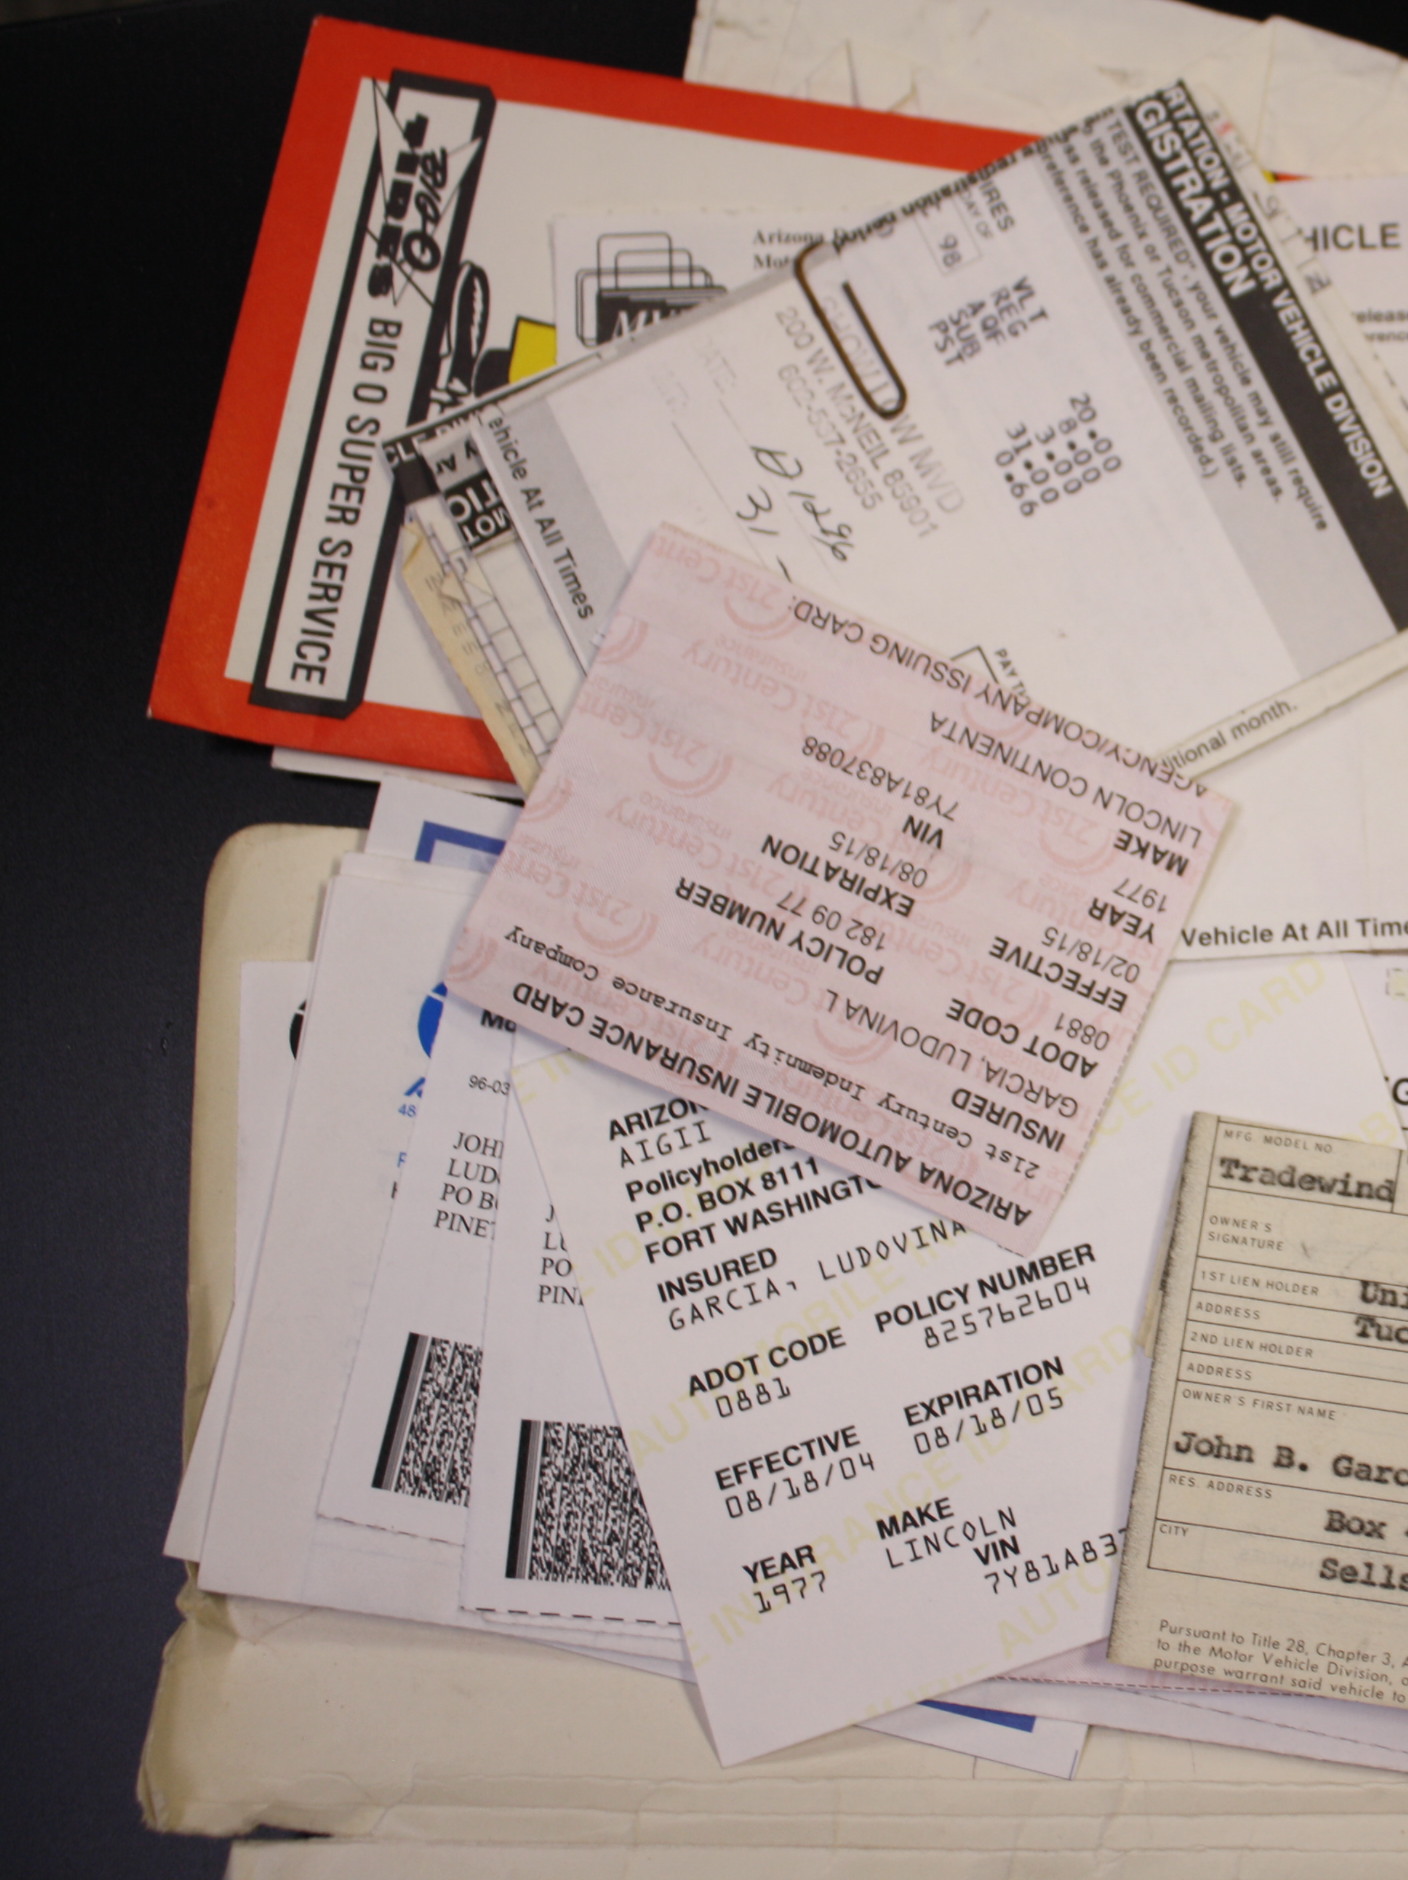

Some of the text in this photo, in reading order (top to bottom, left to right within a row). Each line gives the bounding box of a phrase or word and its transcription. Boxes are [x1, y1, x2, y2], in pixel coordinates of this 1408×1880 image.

[1133, 94, 1257, 298] GISTRATION
[773, 302, 816, 354] 200
[927, 319, 965, 367] PST
[991, 286, 1028, 338] REG
[1105, 168, 1257, 445] Phoenix Tucson metropolitan
[1129, 272, 1193, 374] commercial
[1223, 201, 1283, 290] MOTOR
[1271, 288, 1338, 392] VEHICLE
[1323, 391, 1393, 499] DIVISION
[1161, 386, 1219, 479] recorded.)
[1212, 324, 1329, 532] vehicle require
[288, 316, 403, 686] BIG O SUPER SERVICE
[519, 485, 546, 512] At
[533, 515, 564, 547] All
[551, 547, 596, 620] Times
[786, 595, 972, 693] ISSUING CARD:
[1228, 698, 1298, 740] month.
[800, 734, 1168, 914] 1977 7Y81A837088
[928, 710, 1202, 849] LINCOLN CONTINENTA
[901, 814, 1156, 944] YEAR VIN
[1112, 828, 1189, 876] MAKE
[673, 876, 884, 985] POLICY NUMBER
[760, 833, 1128, 1013] EFFECTIVE EXPIRATION
[827, 830, 1141, 984] 02/18/15 08/18/15
[1180, 923, 1273, 948] Vehicle
[1281, 922, 1308, 941] At
[1315, 919, 1348, 939] All
[775, 889, 1111, 1051] 0881 182 09 77
[503, 924, 1040, 1179] 21st Century Indemnity Insurance Company
[843, 997, 1080, 1119] GARCIA, LUDOVINA
[944, 997, 1098, 1079] ADOT CODE
[511, 981, 1032, 1227] ARIZONA AUTOMOBILE INSURANCE CARD
[618, 1119, 711, 1168] AIGII
[949, 1086, 1066, 1152] INSURED
[440, 1182, 474, 1206] PO
[634, 1155, 819, 1233] P.O. BOX 8111
[1218, 1156, 1398, 1205] Tradewind
[644, 1222, 717, 1264] FORT
[656, 1246, 778, 1303] INSURED
[667, 1217, 967, 1331] GARCIA, LUDOVINA
[1207, 1230, 1284, 1251] SIGNATURE
[687, 1242, 1096, 1396] ADOT CODE POLICY NUMBER
[714, 1275, 1091, 1418] 0881 825762604
[1195, 1300, 1261, 1320] ADDRESS
[714, 1355, 1065, 1490] EFFECTIVE EXPIRATION
[723, 1386, 1064, 1519] 08/18/04 08/18/05
[1173, 1429, 1257, 1465] John
[1272, 1445, 1312, 1472] B.
[741, 1496, 954, 1584] YEAR MAKE
[752, 1505, 1017, 1614] 1977 LINCOLN
[972, 1534, 1021, 1566] VIN
[1158, 1522, 1189, 1537] CITY
[1323, 1508, 1388, 1540] Box
[1158, 1617, 1376, 1669] Pursuant Title Chapter
[1207, 1643, 1255, 1664] Motor
[1262, 1650, 1319, 1674] Vehicle
[1325, 1661, 1394, 1688] Division,
